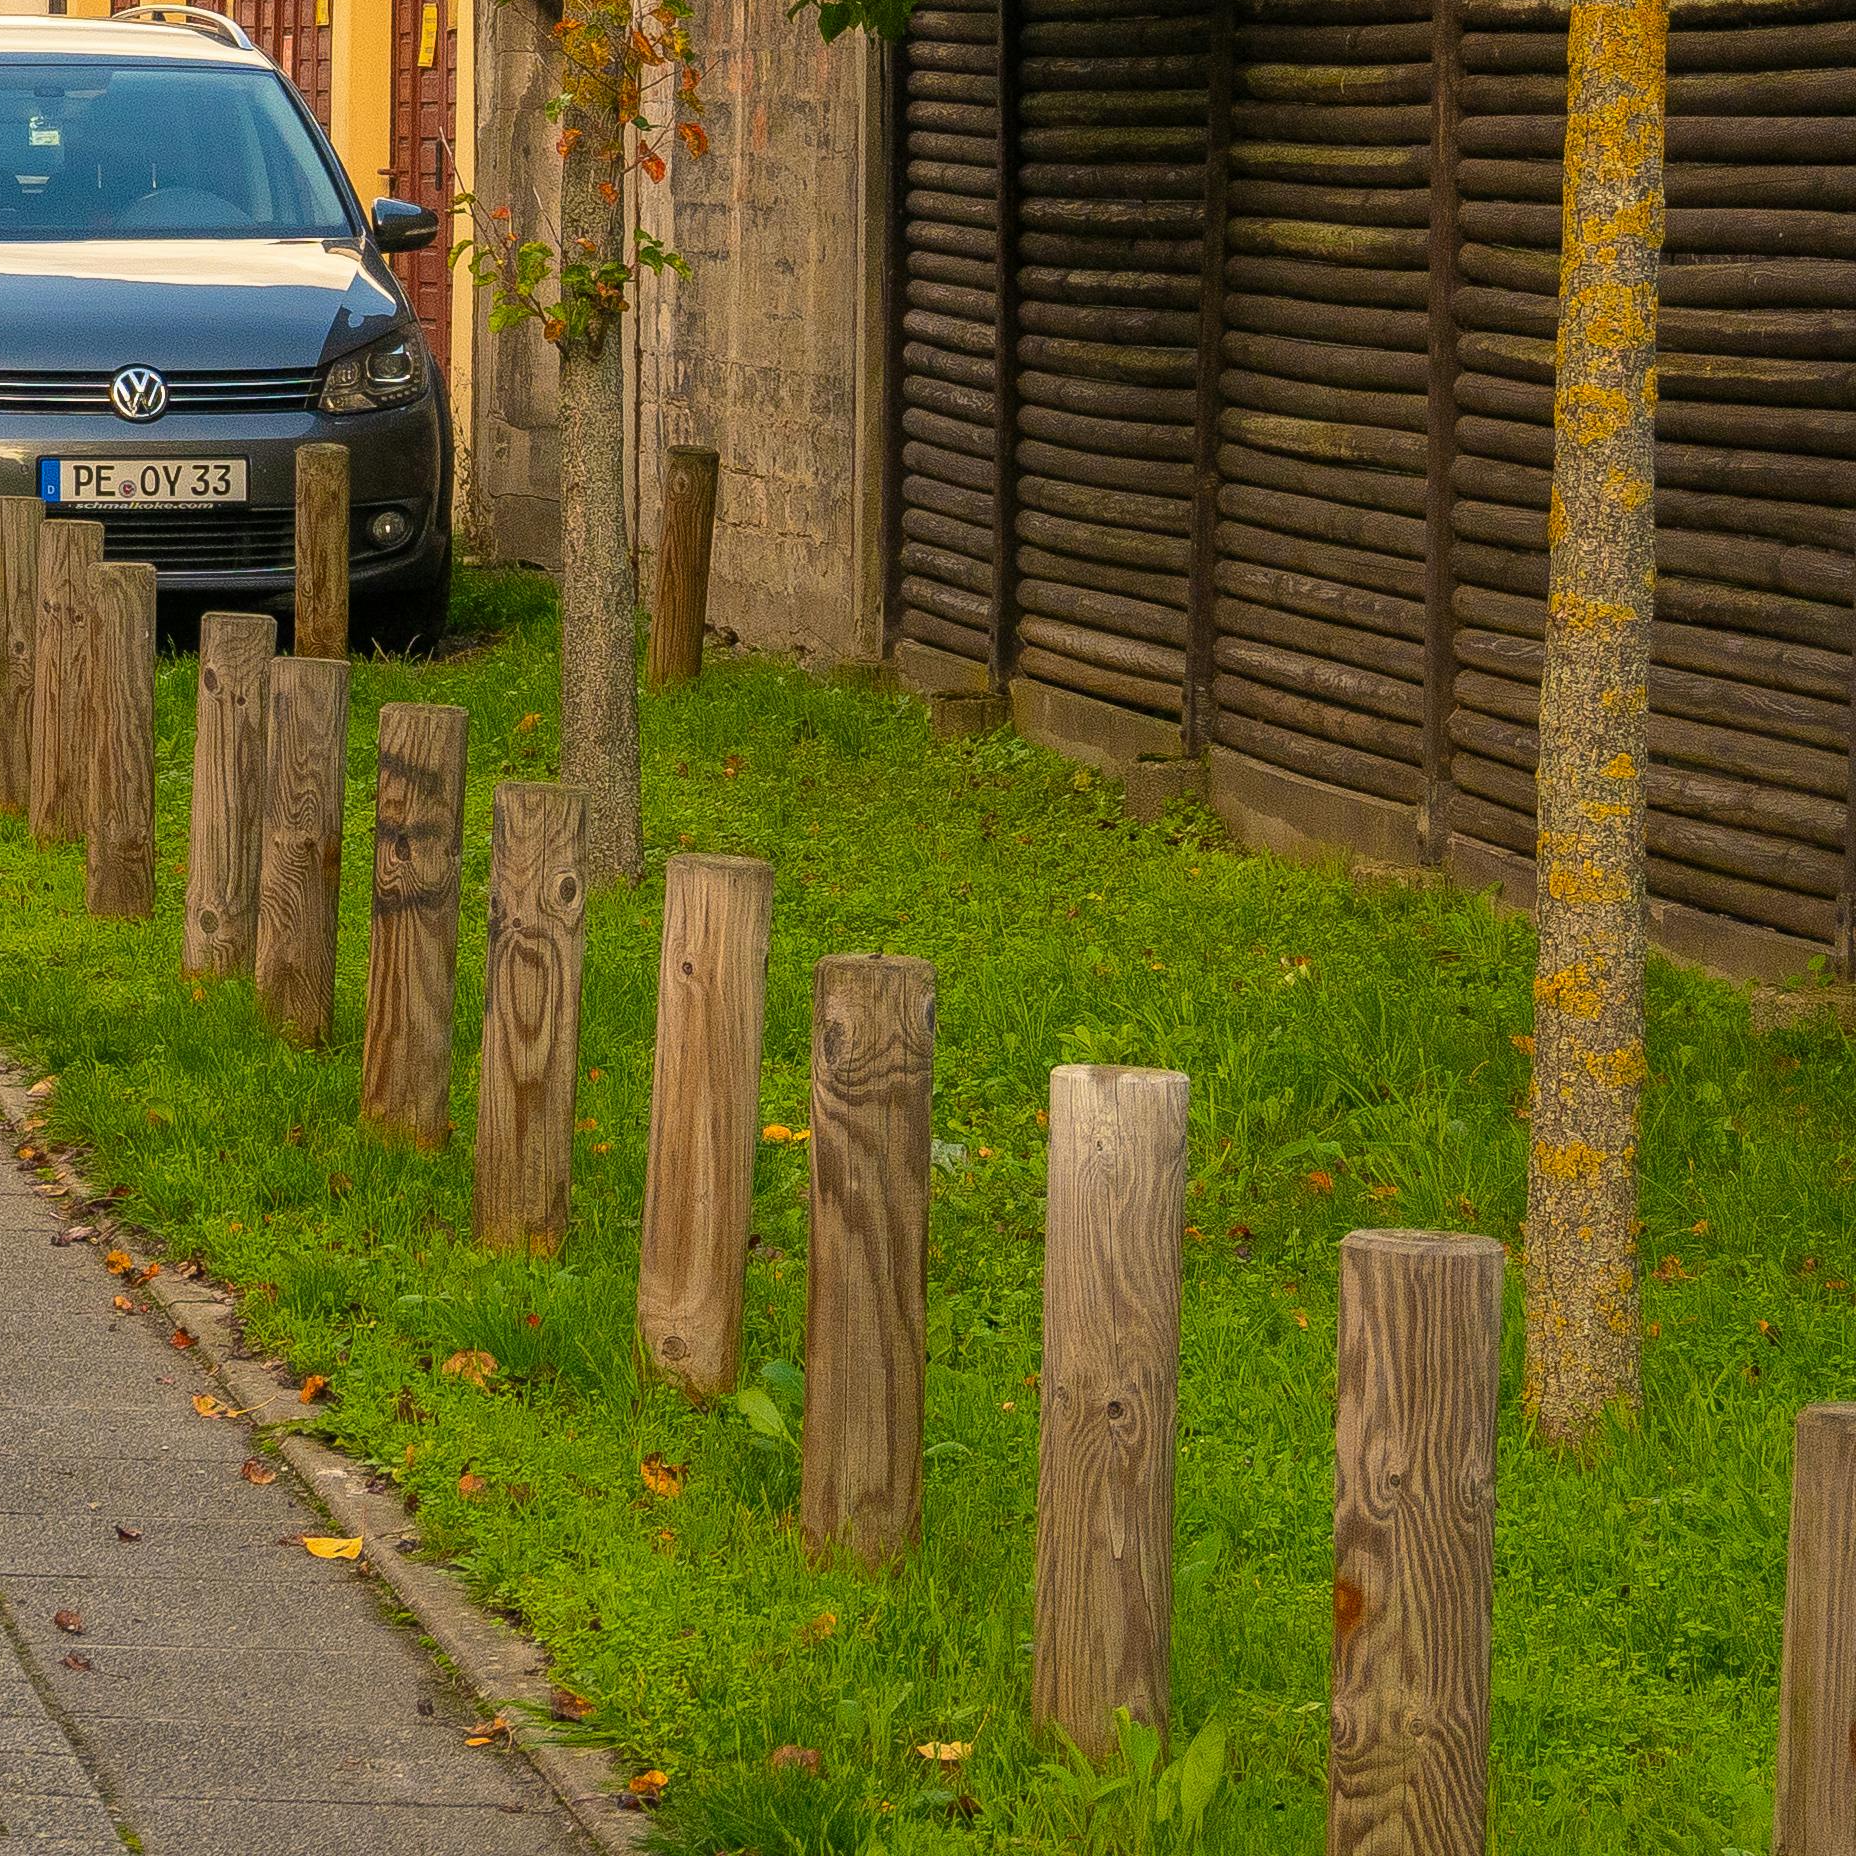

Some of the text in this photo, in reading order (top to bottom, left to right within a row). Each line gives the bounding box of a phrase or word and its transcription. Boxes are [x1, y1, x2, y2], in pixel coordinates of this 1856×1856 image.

[72, 464, 116, 497] PE
[140, 464, 183, 497] OY
[190, 464, 232, 497] 33
[74, 501, 214, 510] schmalkoke.com
